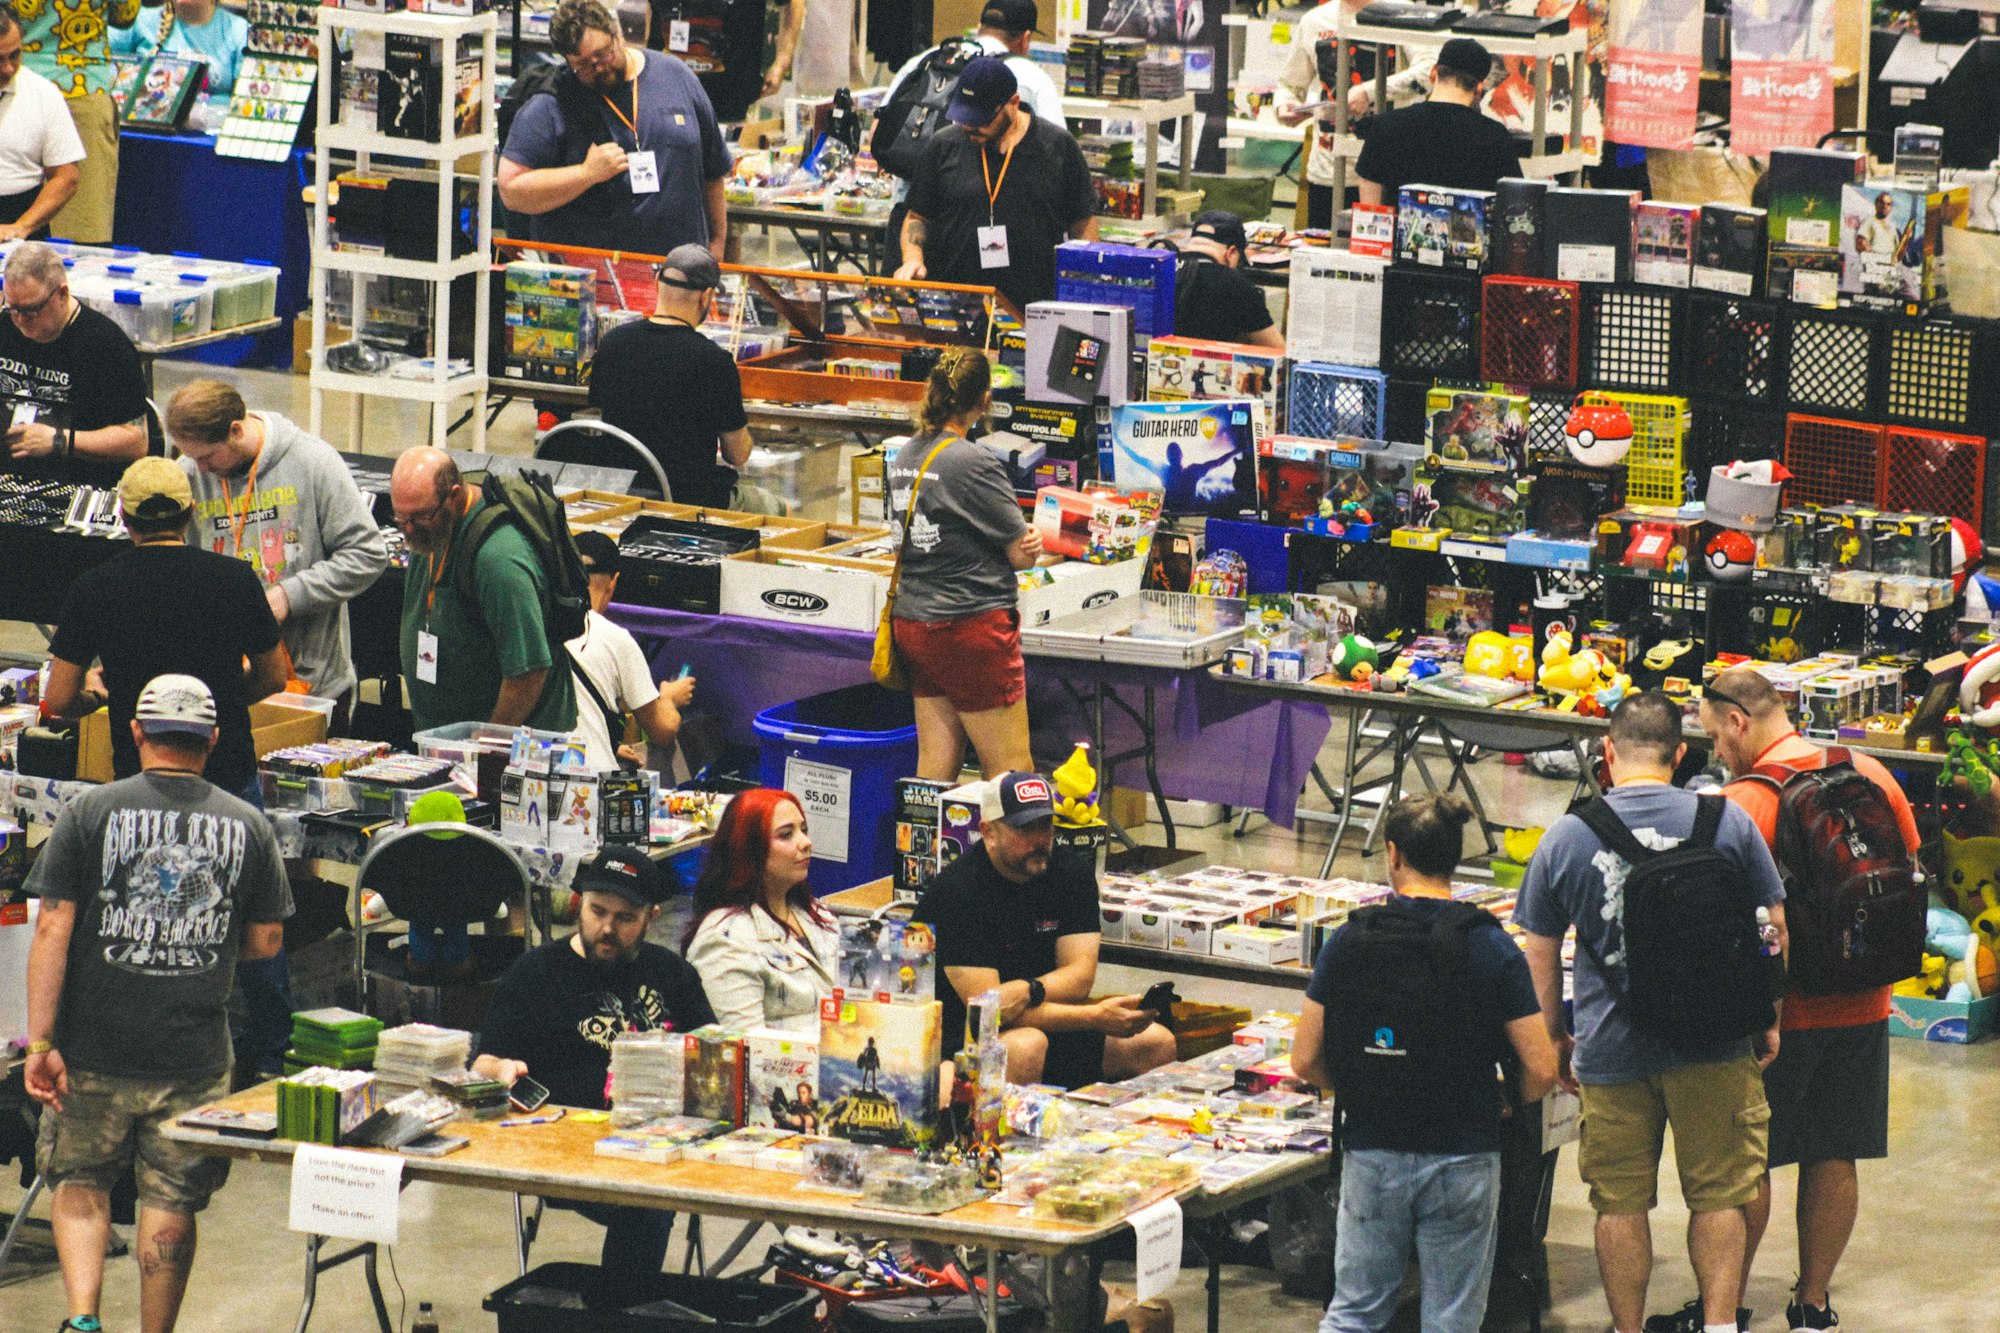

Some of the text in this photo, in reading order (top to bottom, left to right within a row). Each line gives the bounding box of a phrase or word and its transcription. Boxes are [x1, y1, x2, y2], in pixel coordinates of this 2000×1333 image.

[1015, 405, 1074, 417] ENTERTAINMENT
[1011, 422, 1049, 434] CONTROL
[1132, 420, 1169, 438] GUITAR
[1170, 418, 1198, 437] HERO
[1331, 451, 1361, 463] GODZILLA
[93, 513, 113, 522] FLASK
[774, 593, 815, 608] BCW
[1089, 594, 1113, 608] BCW
[804, 789, 837, 806] $5.00
[903, 784, 939, 797] STAR
[904, 794, 940, 806] WARS
[810, 805, 829, 813] EACH
[102, 808, 246, 894] GUILT TRIP
[838, 1096, 898, 1125] ZELDA
[308, 1156, 329, 1168] Love
[331, 1160, 346, 1170] the
[369, 1166, 386, 1177] but
[314, 1173, 376, 1191] not the price?
[312, 1202, 376, 1221] Make an offer!
